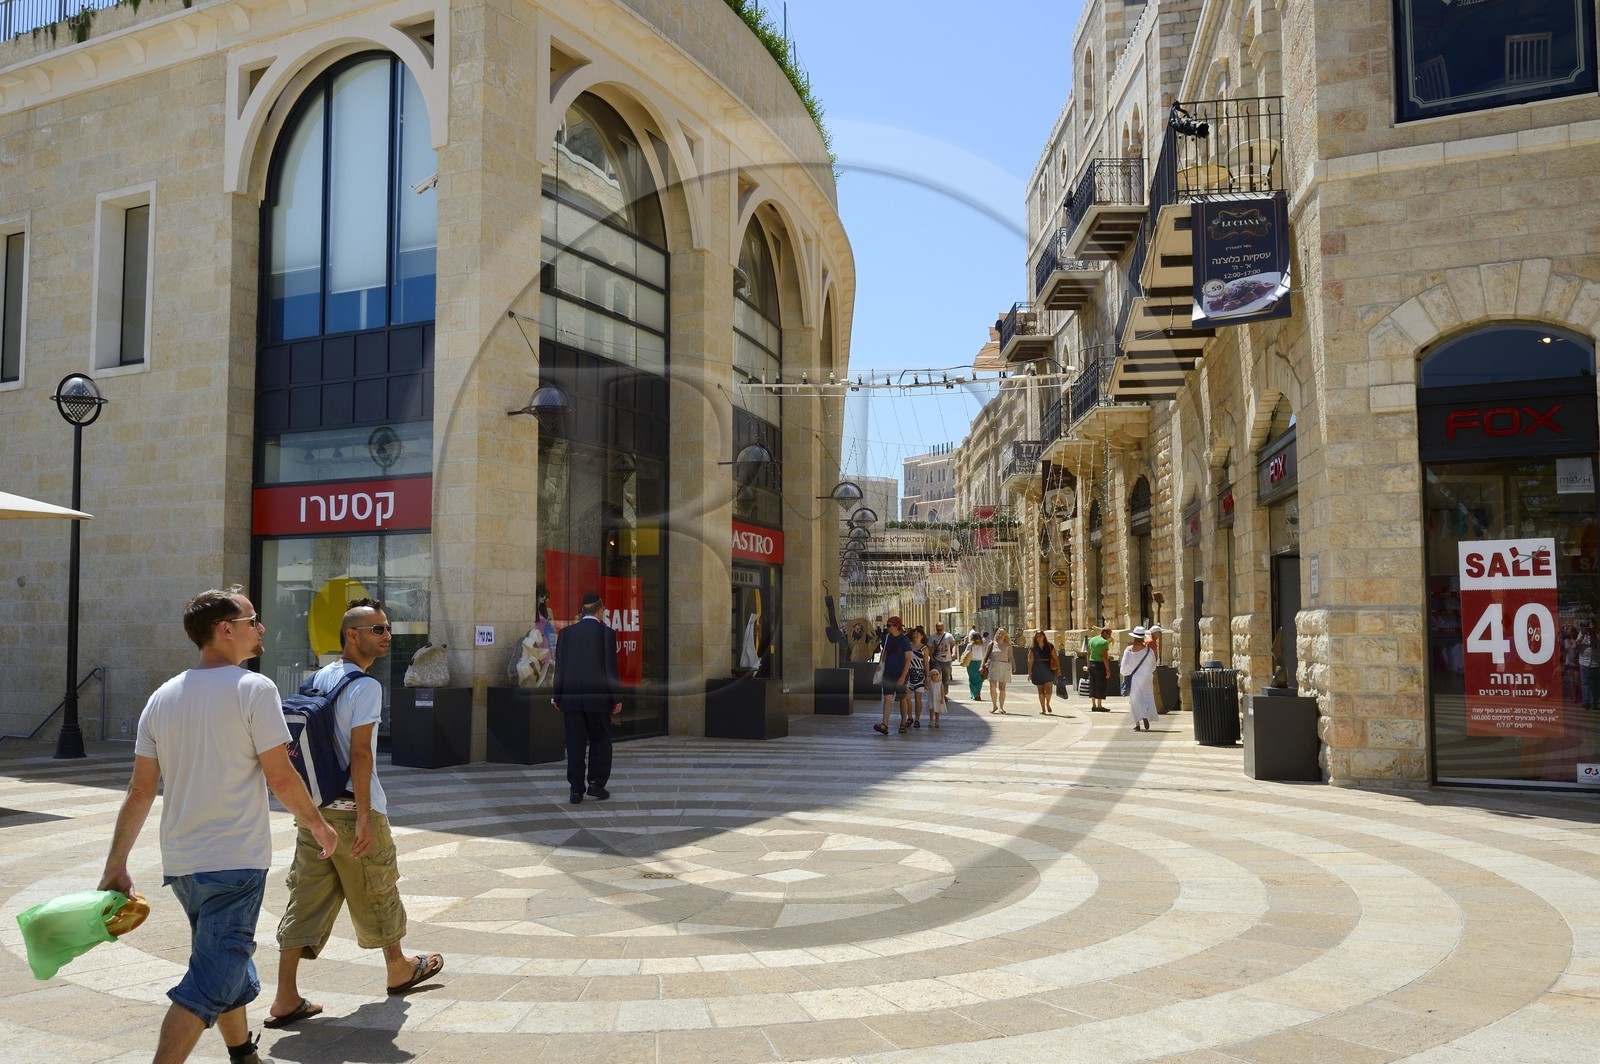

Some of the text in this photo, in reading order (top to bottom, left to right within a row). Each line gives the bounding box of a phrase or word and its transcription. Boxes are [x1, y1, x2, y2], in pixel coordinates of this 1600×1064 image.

[1221, 219, 1260, 228] LUCIANA
[1242, 251, 1272, 262] עסקיות
[1223, 268, 1261, 279] 12:00-17:00
[1446, 403, 1565, 440] FOX
[299, 490, 395, 528] קסטרו
[1465, 547, 1552, 577] SALE
[602, 608, 640, 632] SALE
[1466, 602, 1555, 665] 40
[623, 640, 637, 657] סוף
[1490, 672, 1535, 685] הנחה
[1478, 687, 1548, 698] על מגוון פריטים
